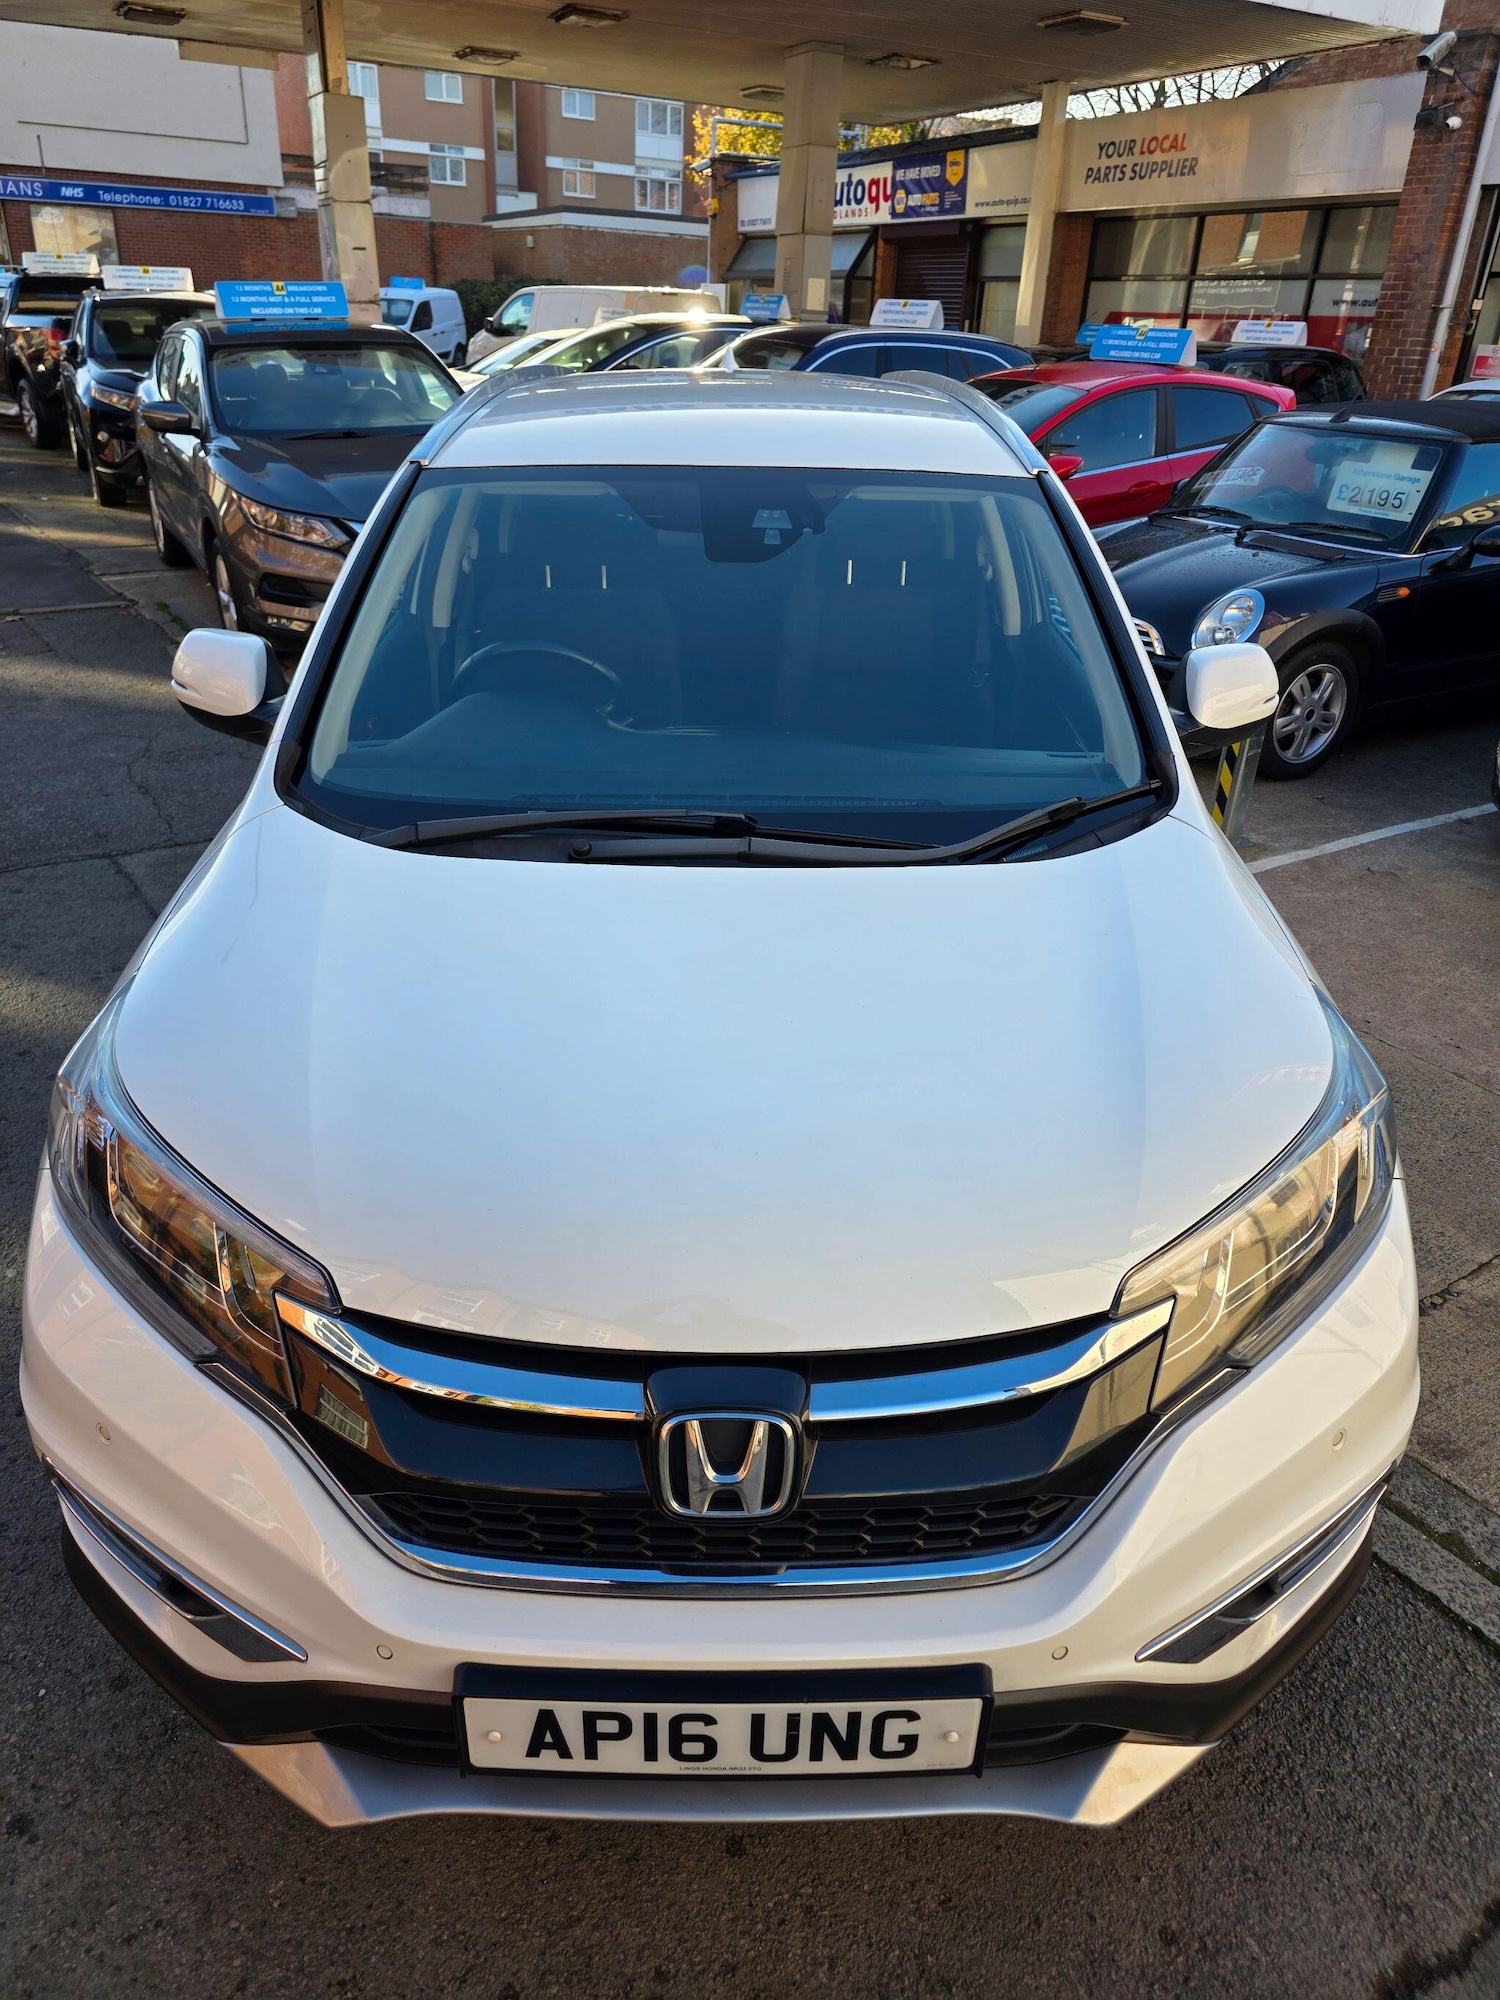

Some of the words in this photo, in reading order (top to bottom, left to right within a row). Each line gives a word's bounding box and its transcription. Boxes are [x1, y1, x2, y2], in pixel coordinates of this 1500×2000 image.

[1098, 139, 1136, 160] YOUR
[1139, 133, 1187, 155] LOCAL
[896, 169, 904, 180] WE
[905, 166, 920, 179] HAVE
[921, 165, 941, 178] MOVED
[1084, 164, 1127, 184] PARTS
[1129, 157, 1199, 181] SUPPLIER
[61, 186, 84, 197] NHS
[98, 191, 164, 205] Telephone:
[169, 195, 202, 207] 01827
[205, 198, 245, 210] 716633
[1394, 473, 1422, 484] Garage
[1336, 484, 1406, 509] £2195
[524, 1708, 718, 1762] AP16
[749, 1709, 922, 1762] UNG
